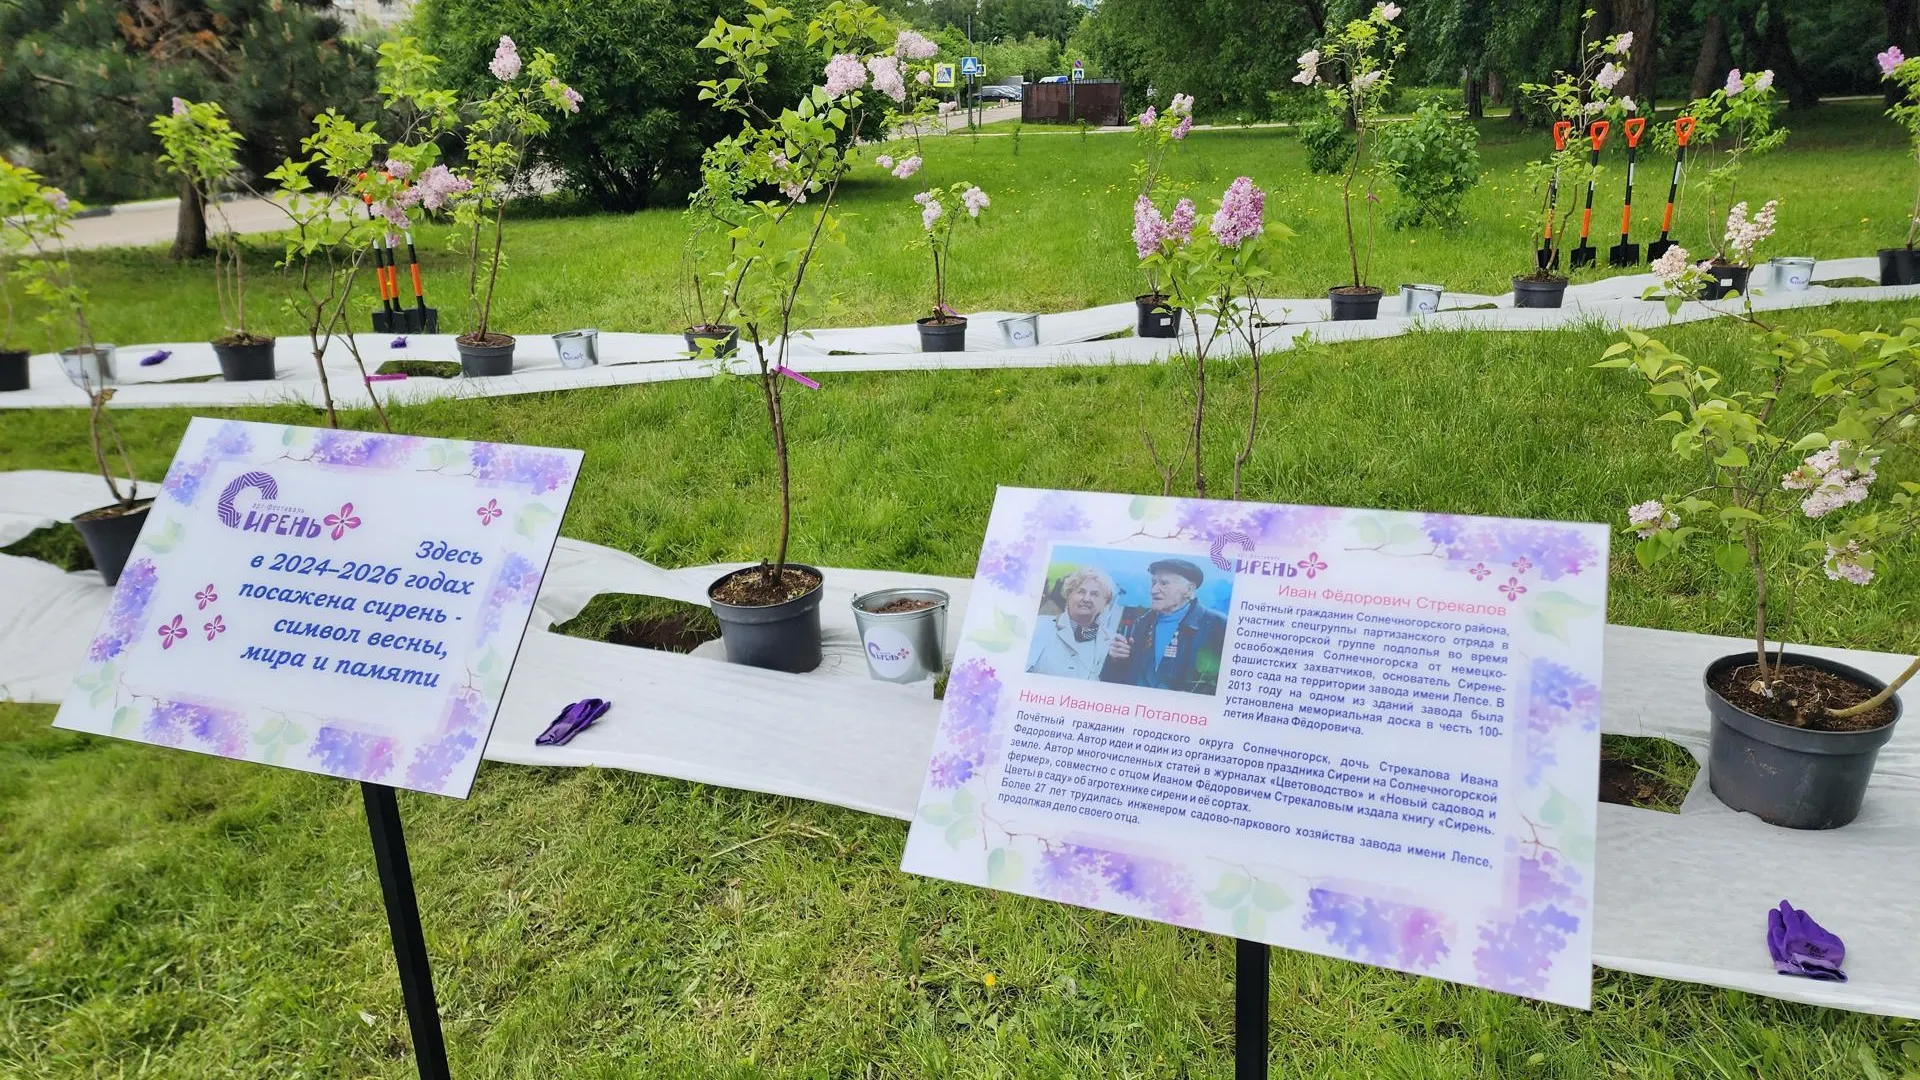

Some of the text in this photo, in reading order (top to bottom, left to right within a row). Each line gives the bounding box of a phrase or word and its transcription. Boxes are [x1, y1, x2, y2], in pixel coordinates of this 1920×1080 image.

[414, 539, 483, 565] Здесь
[249, 554, 265, 568] в
[403, 569, 475, 595] годах
[237, 582, 357, 611] посажена
[362, 599, 447, 623] сирень
[1239, 599, 1509, 636] Почётный гражданин Солнечногорского района,
[1277, 583, 1506, 616] Иван Фёдорович Стрекалов
[272, 618, 447, 660] символ весны,
[1235, 625, 1508, 664] Солнечногорской группе подполья во время
[1237, 615, 1509, 650] участник спецгруппы партизанского отряда в
[239, 645, 440, 688] мира и памяти
[1230, 652, 1506, 693] фашистских захватчиков, основатель Сирене-
[1233, 641, 1507, 678] освобождения Солнечногорска от немецко-
[1018, 688, 1208, 726] Нина Ивановна Потапова
[1226, 678, 1504, 723] 2013 году на одном из зданий завода была
[1229, 667, 1505, 708] вого сада на территории завода имени Лепсе. В
[1222, 708, 1364, 735] летия Ивана Фёдоровича.
[1224, 694, 1503, 737] установлена мемориальная доска в честь 100-
[1012, 722, 1497, 803] Федоровича. Автор идеи и один из организаторов праздника Сирени на Солнечногорской
[1015, 709, 1498, 788] Почётный гражданин городского округа Солнечногорск, дочь Стрекалова Ивана
[1003, 762, 1251, 812] Цветы в саду» об агротехнике сирени и её сортах.
[1006, 749, 1495, 835] фермер», совместно с отцом Иваном Фёдоровичем Стрекаловым издала книгу «Сирень.
[1009, 737, 1496, 819] земле. Автор многочисленных статей в журналах «Цветоводство» и «Новый садовод и
[997, 792, 1140, 825] продолжая дело своего отца.
[1000, 776, 1492, 868] Более 27 лет трудилась инженером садово-паркового хозяйства завода имени Лепсе,
